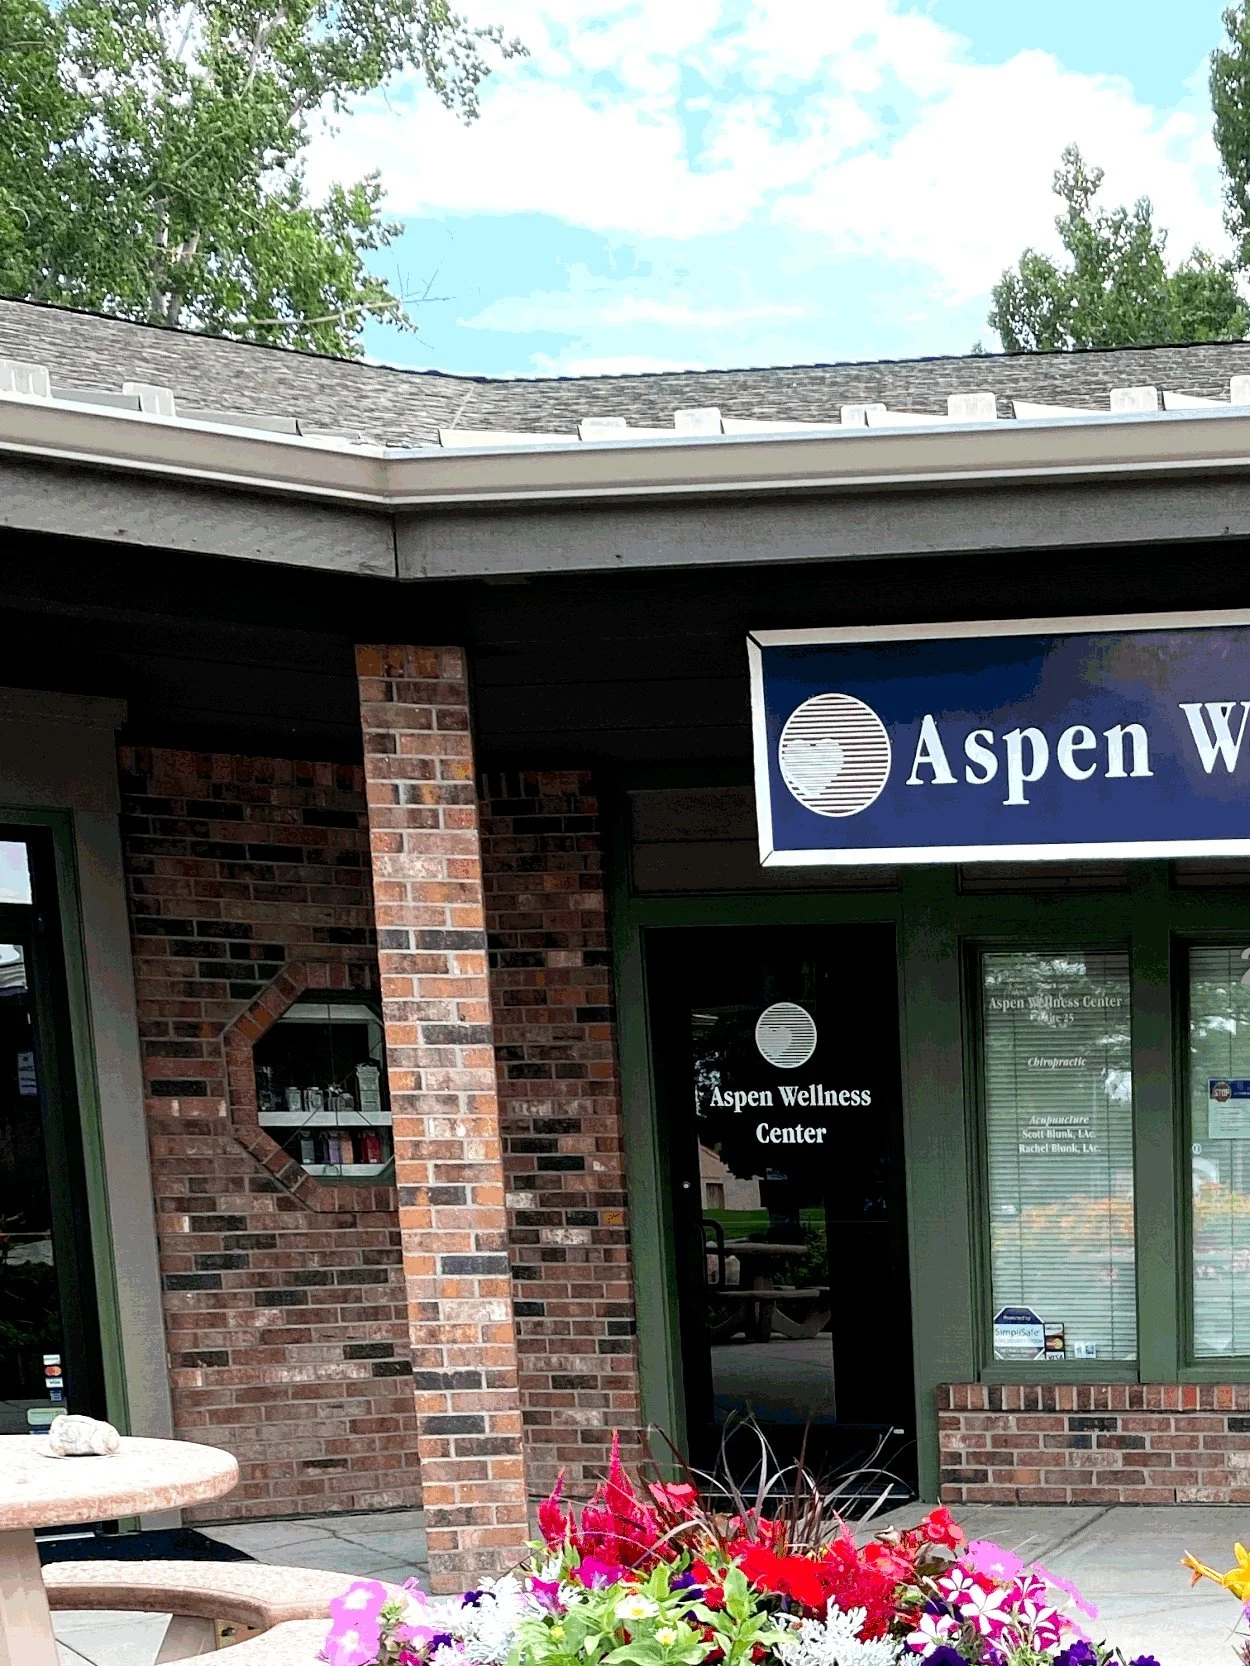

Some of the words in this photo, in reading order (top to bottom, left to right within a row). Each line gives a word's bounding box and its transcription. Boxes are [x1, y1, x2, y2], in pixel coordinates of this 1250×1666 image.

[906, 714, 1155, 806] Aspen
[988, 996, 1025, 1013] Aspen
[1028, 995, 1080, 1008] Wellness
[1083, 995, 1123, 1008] Center
[1027, 1056, 1088, 1069] Chiropractic
[709, 1086, 774, 1113] Aspen
[777, 1084, 872, 1107] Wellness
[1214, 1088, 1230, 1097] STOP
[1029, 1115, 1090, 1127] Acupuncture
[755, 1122, 827, 1144] Center
[1022, 1129, 1044, 1139] Scott
[1046, 1129, 1076, 1140] Blunk,
[1018, 1143, 1049, 1153] Rachel
[995, 1328, 1039, 1337] SimpliSafe
